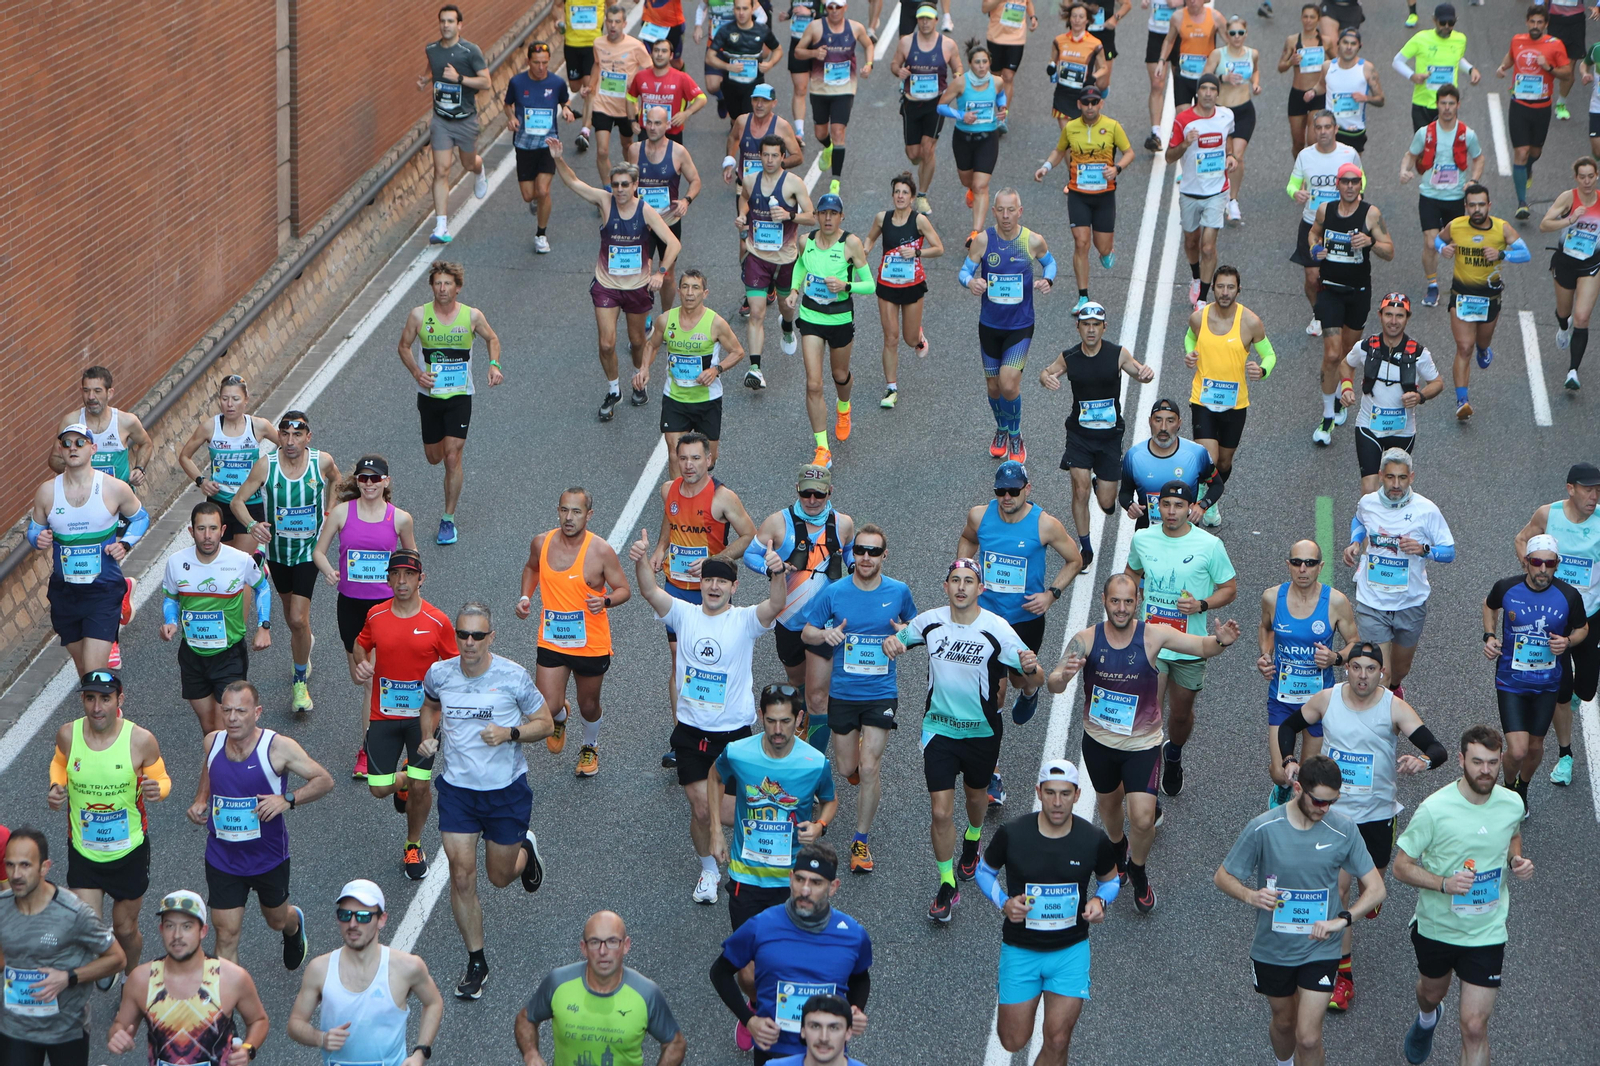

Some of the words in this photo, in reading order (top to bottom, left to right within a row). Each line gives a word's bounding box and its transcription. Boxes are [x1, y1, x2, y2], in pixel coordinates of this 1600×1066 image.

[428, 333, 462, 343] melgar
[668, 340, 702, 350] melgar
[680, 525, 712, 533] CAMAS
[73, 548, 96, 556] ZURICH
[998, 556, 1021, 566] ZURICH
[1160, 610, 1183, 618] ZURICH
[950, 640, 984, 656] INTER
[944, 652, 984, 665] RUNNERS
[698, 671, 722, 681] ZURICH
[1095, 671, 1123, 679] PÉGATE
[696, 685, 710, 694] 4976
[1106, 693, 1132, 704] ZURICH
[1104, 706, 1118, 714] 4587
[930, 713, 949, 725] INTER
[949, 720, 981, 729] CROSSFIT
[1100, 713, 1122, 724] ROBERTO
[1342, 754, 1368, 763] ZURICH
[90, 782, 130, 790] TRIATLÓN
[106, 788, 128, 796] REAL
[96, 813, 122, 822] ZURICH
[1474, 871, 1496, 882] ZURICH
[798, 988, 828, 996] ZURICH
[596, 1026, 625, 1034] MARATÓN
[582, 1034, 623, 1044] SEVILLA
